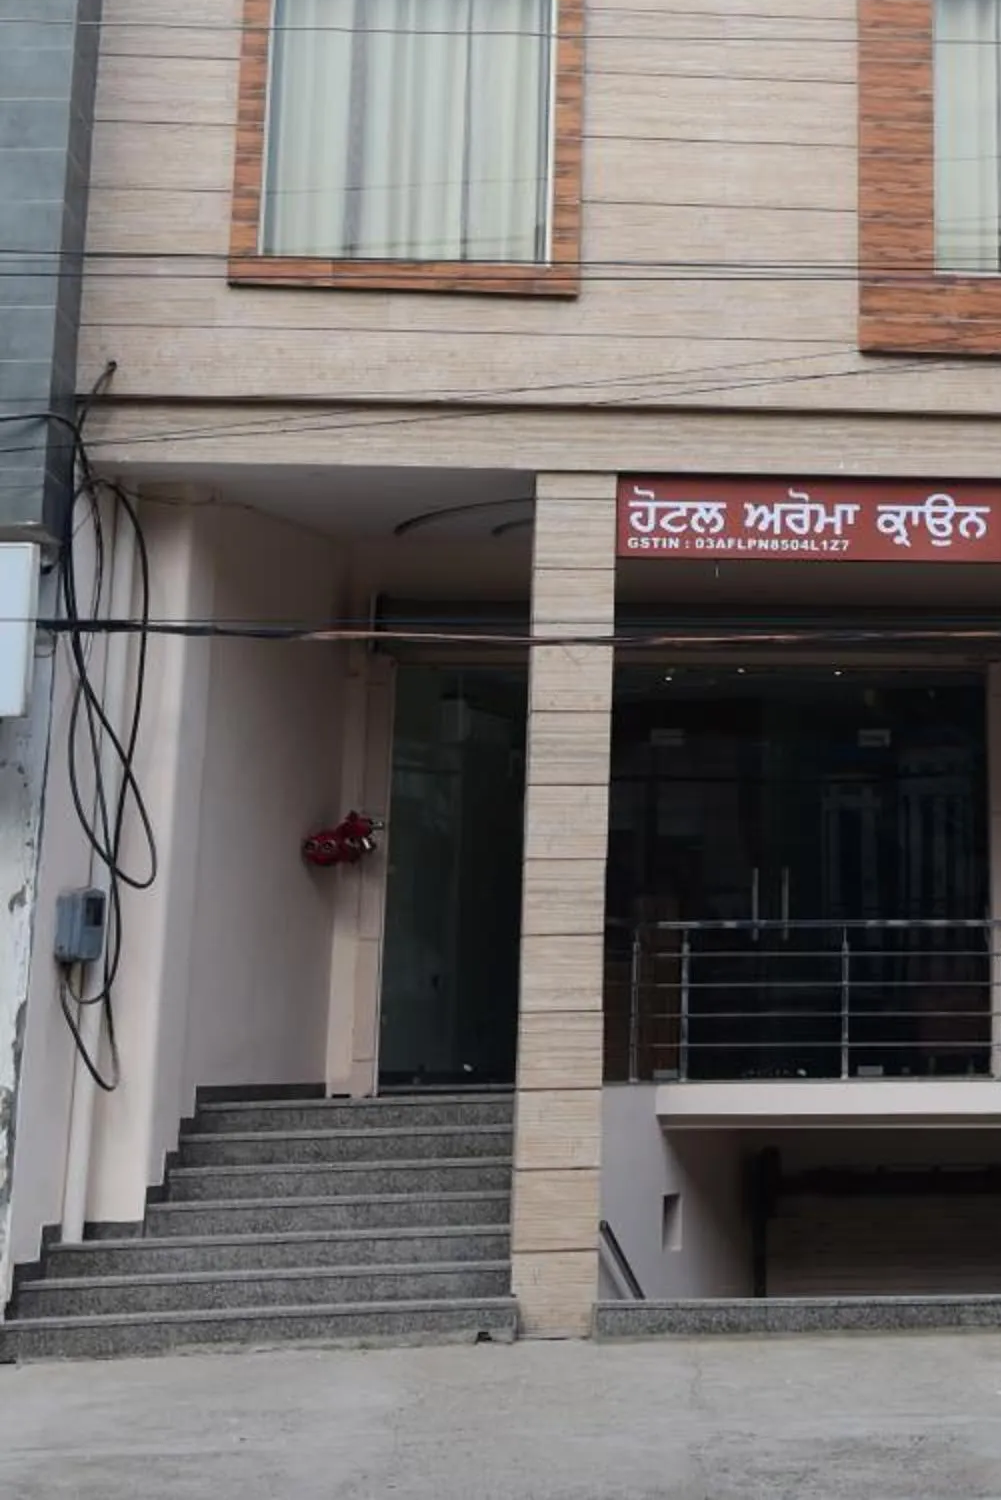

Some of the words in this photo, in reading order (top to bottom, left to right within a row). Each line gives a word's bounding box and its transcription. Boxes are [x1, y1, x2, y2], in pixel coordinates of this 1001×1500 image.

[627, 485, 727, 534] ਹੋਟਲ
[743, 487, 861, 535] ਅਰੋਮਾ
[627, 537, 680, 549] GSTIN
